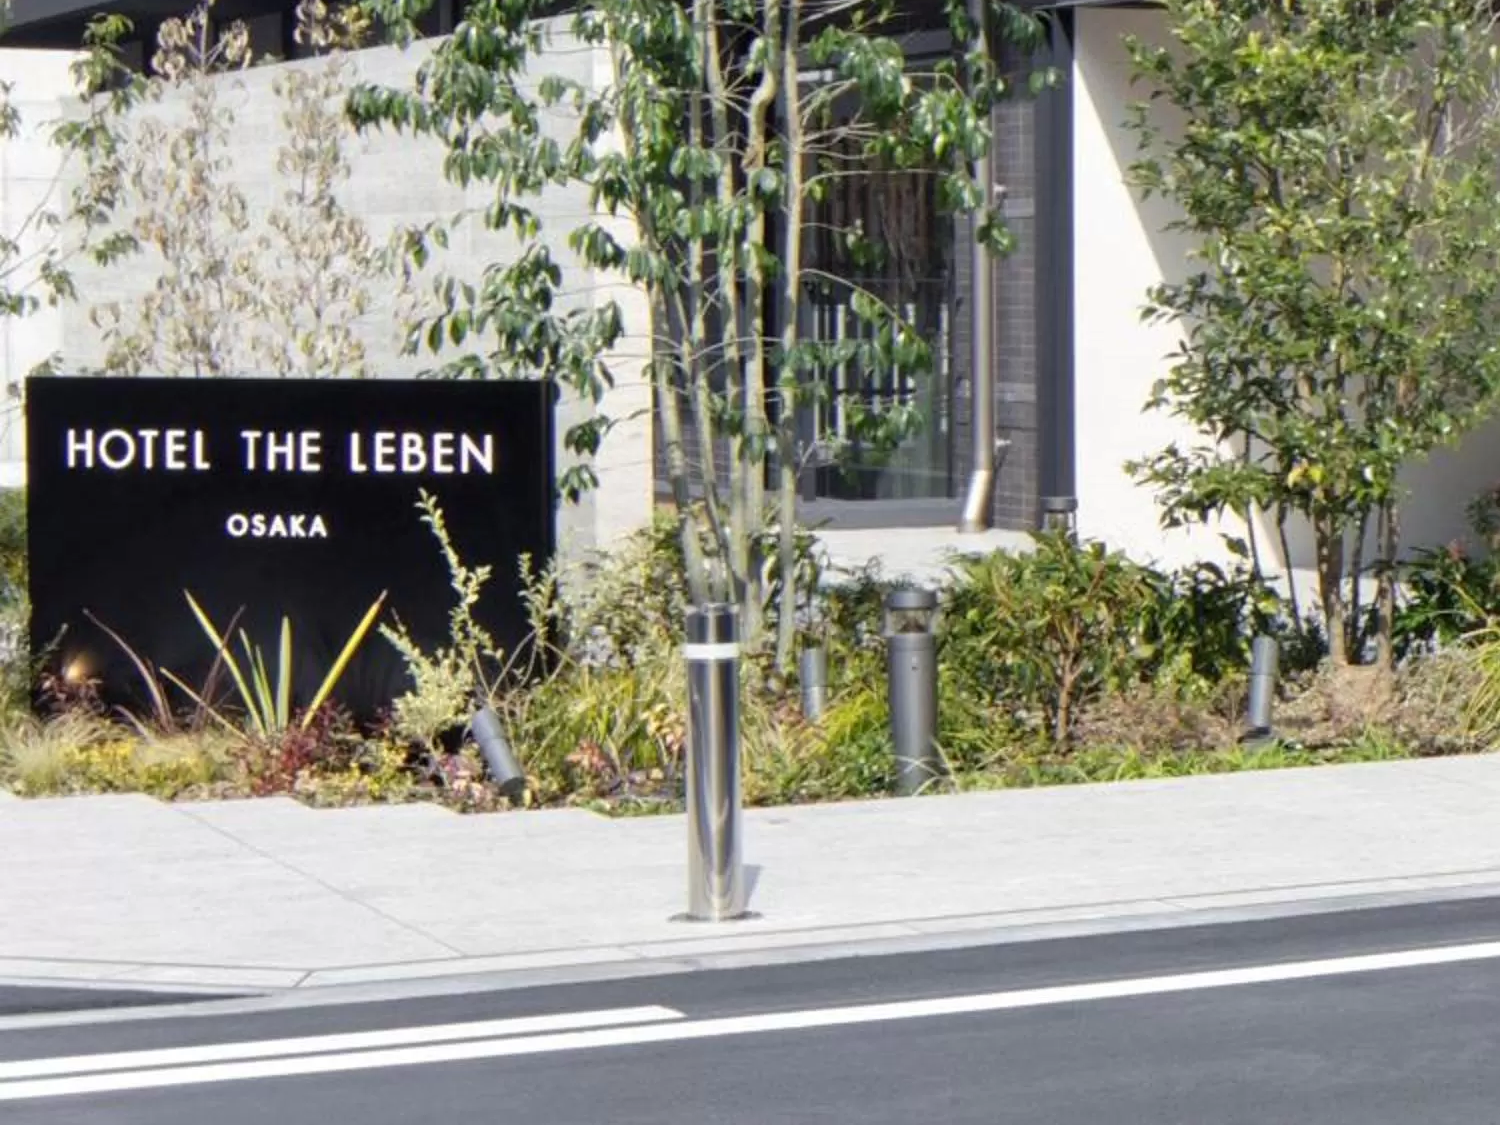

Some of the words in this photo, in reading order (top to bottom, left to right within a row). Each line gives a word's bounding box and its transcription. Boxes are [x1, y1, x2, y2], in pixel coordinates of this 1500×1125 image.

[66, 428, 211, 470] HOTEL
[240, 430, 322, 472] THE
[350, 432, 495, 474] LEBEN
[226, 513, 328, 538] OSAKA
